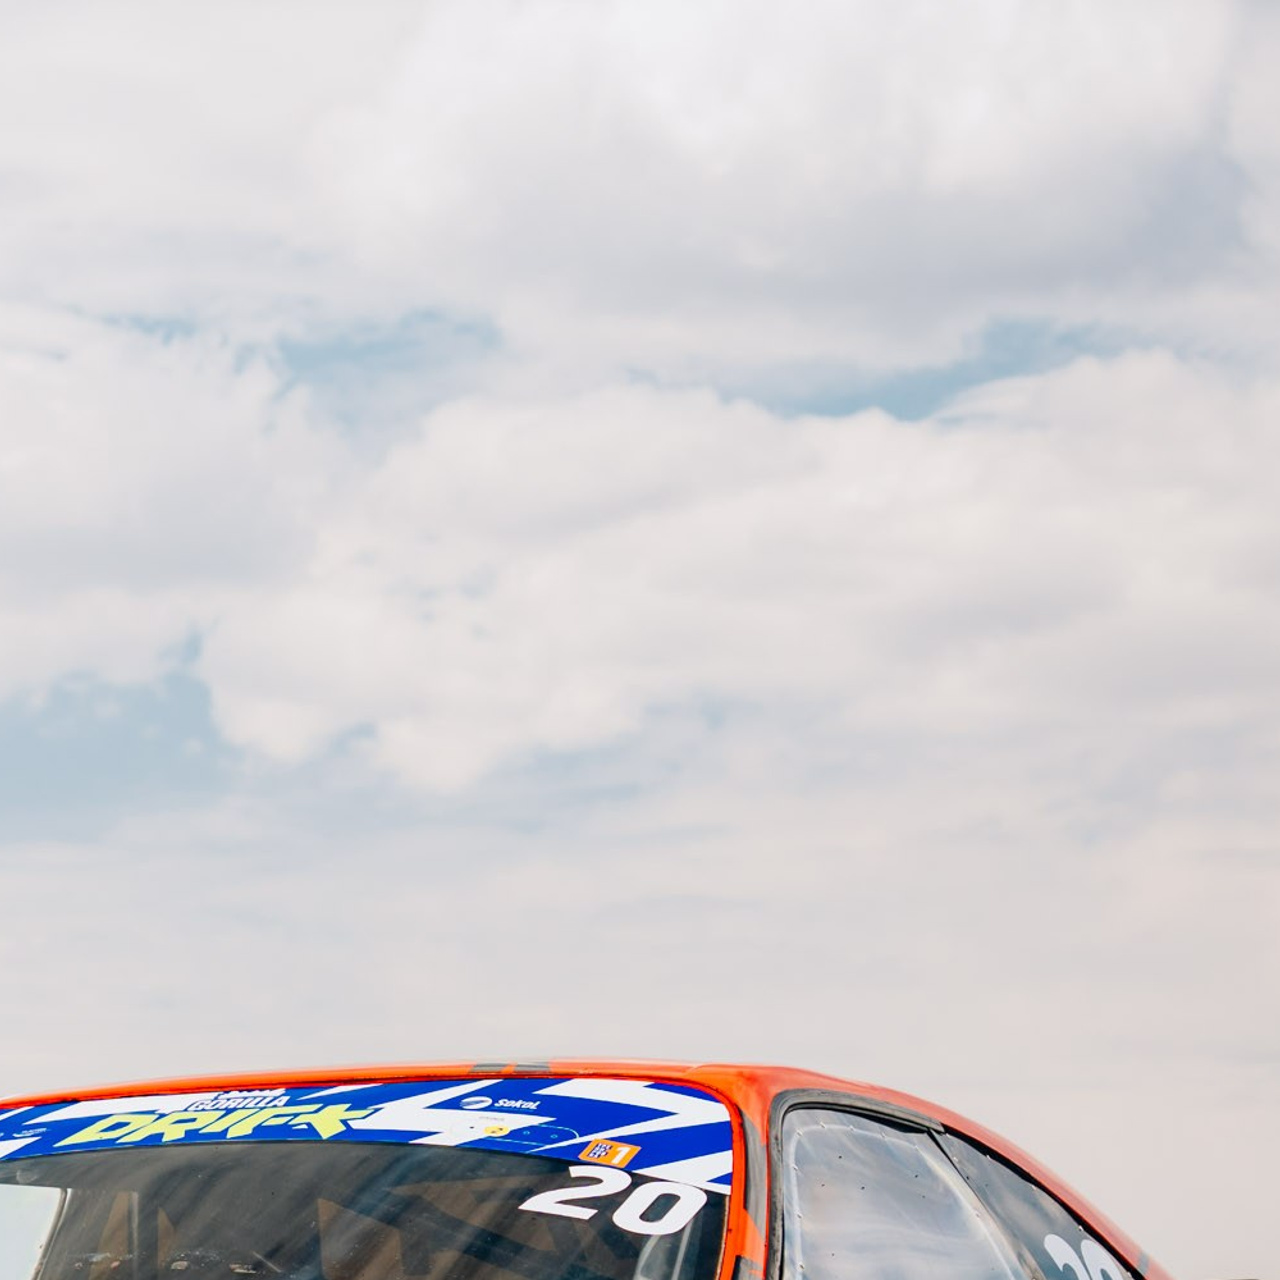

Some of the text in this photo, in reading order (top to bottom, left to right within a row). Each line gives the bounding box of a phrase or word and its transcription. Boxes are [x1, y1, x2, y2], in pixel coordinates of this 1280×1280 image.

[53, 1103, 376, 1147] DRIFT
[187, 1096, 291, 1111] GORILLA
[518, 1165, 708, 1236] 20
